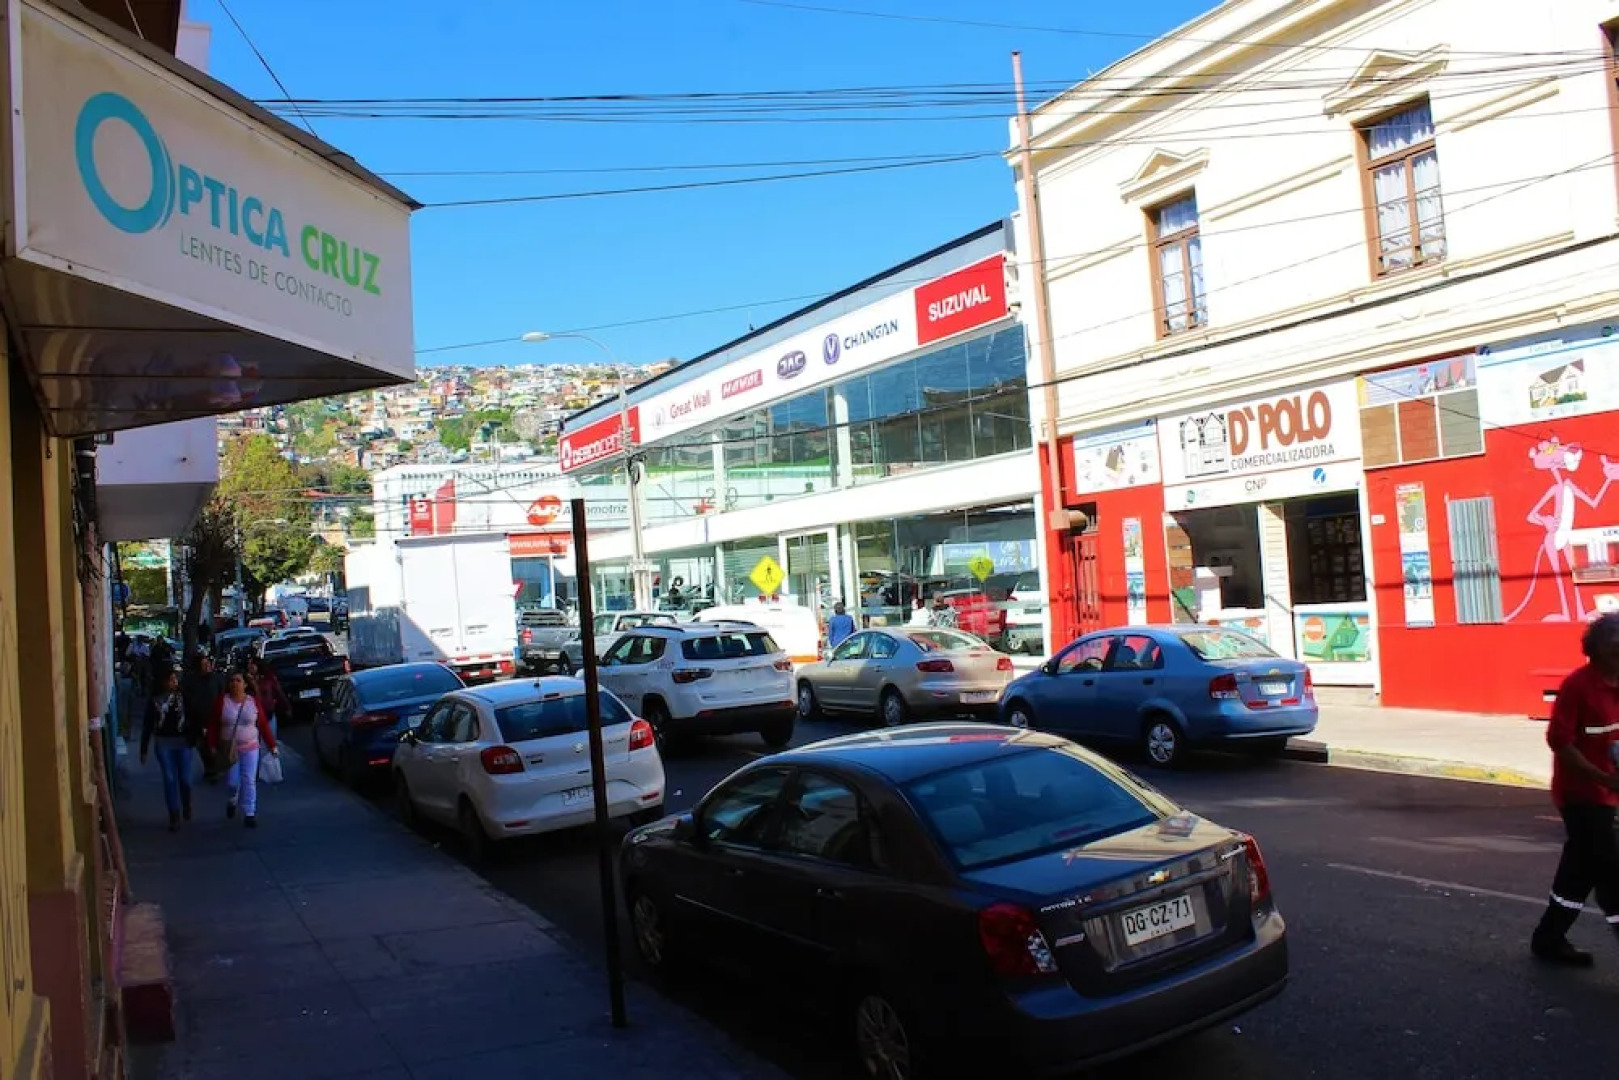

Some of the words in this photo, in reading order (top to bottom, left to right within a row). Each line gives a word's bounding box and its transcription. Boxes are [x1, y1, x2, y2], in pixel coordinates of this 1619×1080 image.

[179, 231, 243, 275] LENTES
[248, 258, 270, 286] DE
[274, 271, 353, 317] CONTACTO
[301, 224, 382, 295] CRUZ
[928, 284, 991, 322] SUZUVAL
[844, 319, 899, 350] CHANGAN
[779, 353, 805, 374] JAC
[669, 401, 692, 419] Great
[692, 392, 712, 409] Wall
[1230, 443, 1335, 471] COMERCIALIZADORA
[1244, 477, 1268, 492] CNP
